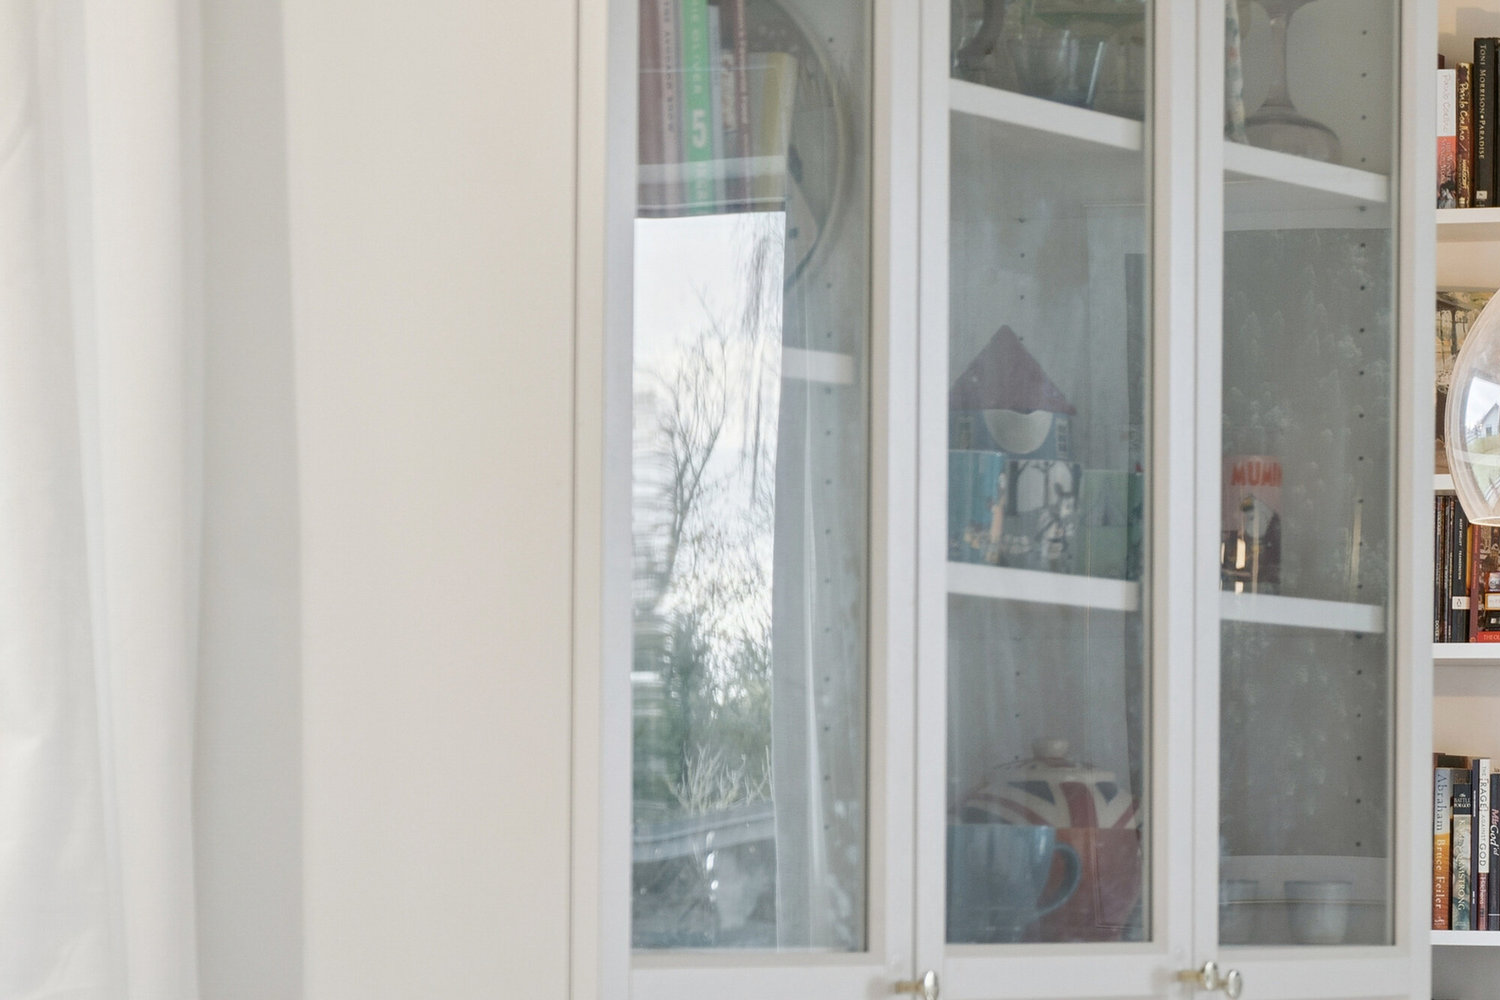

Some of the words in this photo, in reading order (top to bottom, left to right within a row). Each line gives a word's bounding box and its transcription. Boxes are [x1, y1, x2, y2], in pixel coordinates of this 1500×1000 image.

[1436, 774, 1447, 831] Abraham
[1436, 839, 1446, 871] Bruce
[1436, 876, 1447, 909] Feiler
